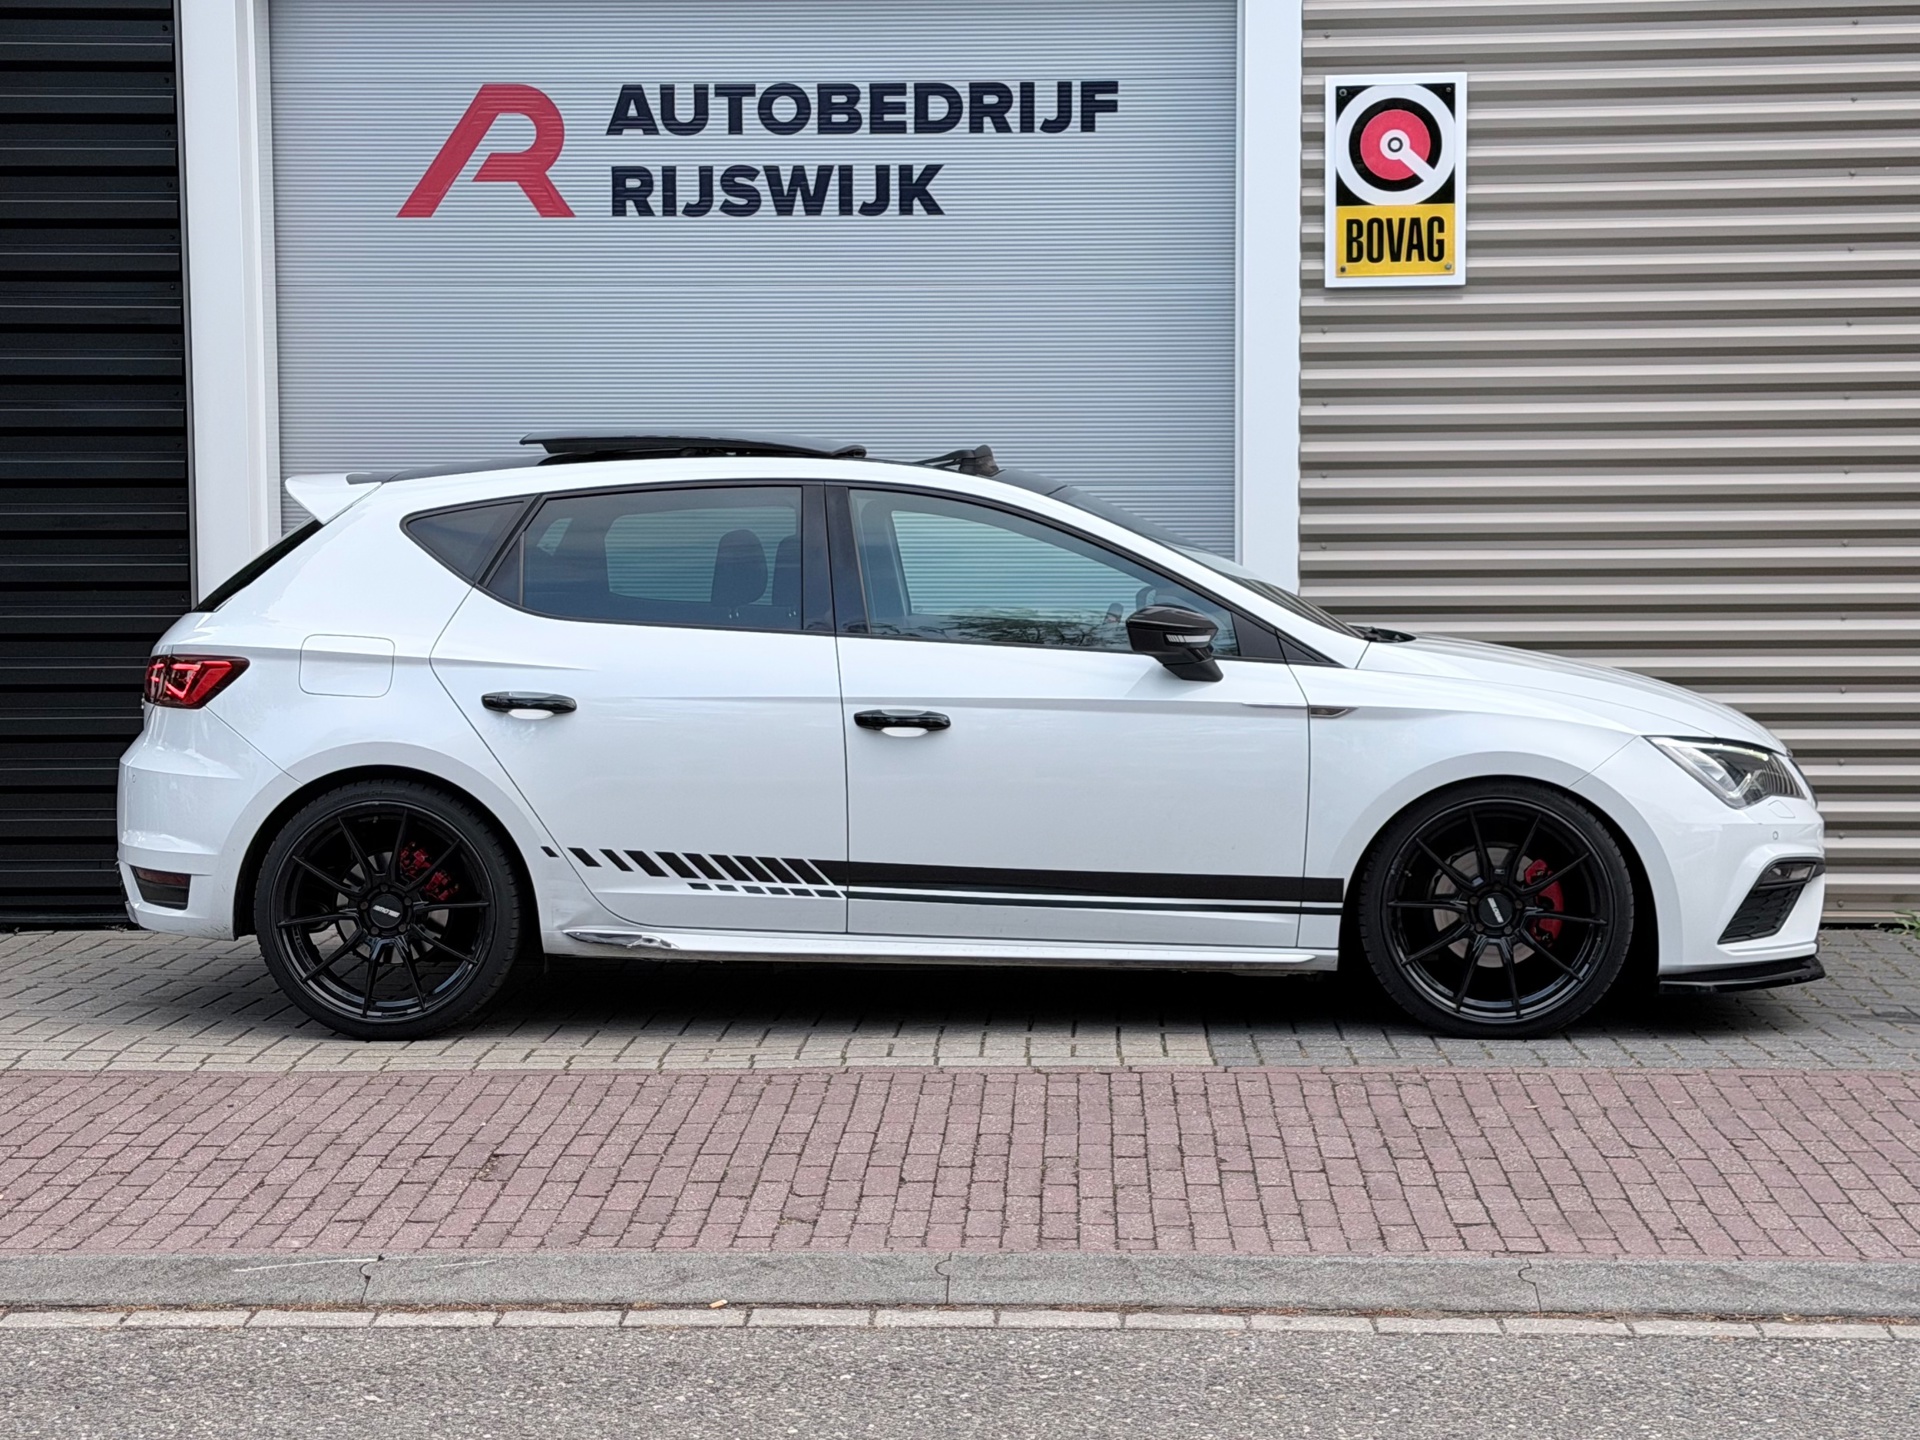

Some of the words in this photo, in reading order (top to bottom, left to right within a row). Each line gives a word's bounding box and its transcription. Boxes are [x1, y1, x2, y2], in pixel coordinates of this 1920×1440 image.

[606, 80, 1119, 137] AUTOBEDRIJF
[610, 163, 946, 218] RIJSWIJK
[1346, 215, 1446, 264] BOVAG
